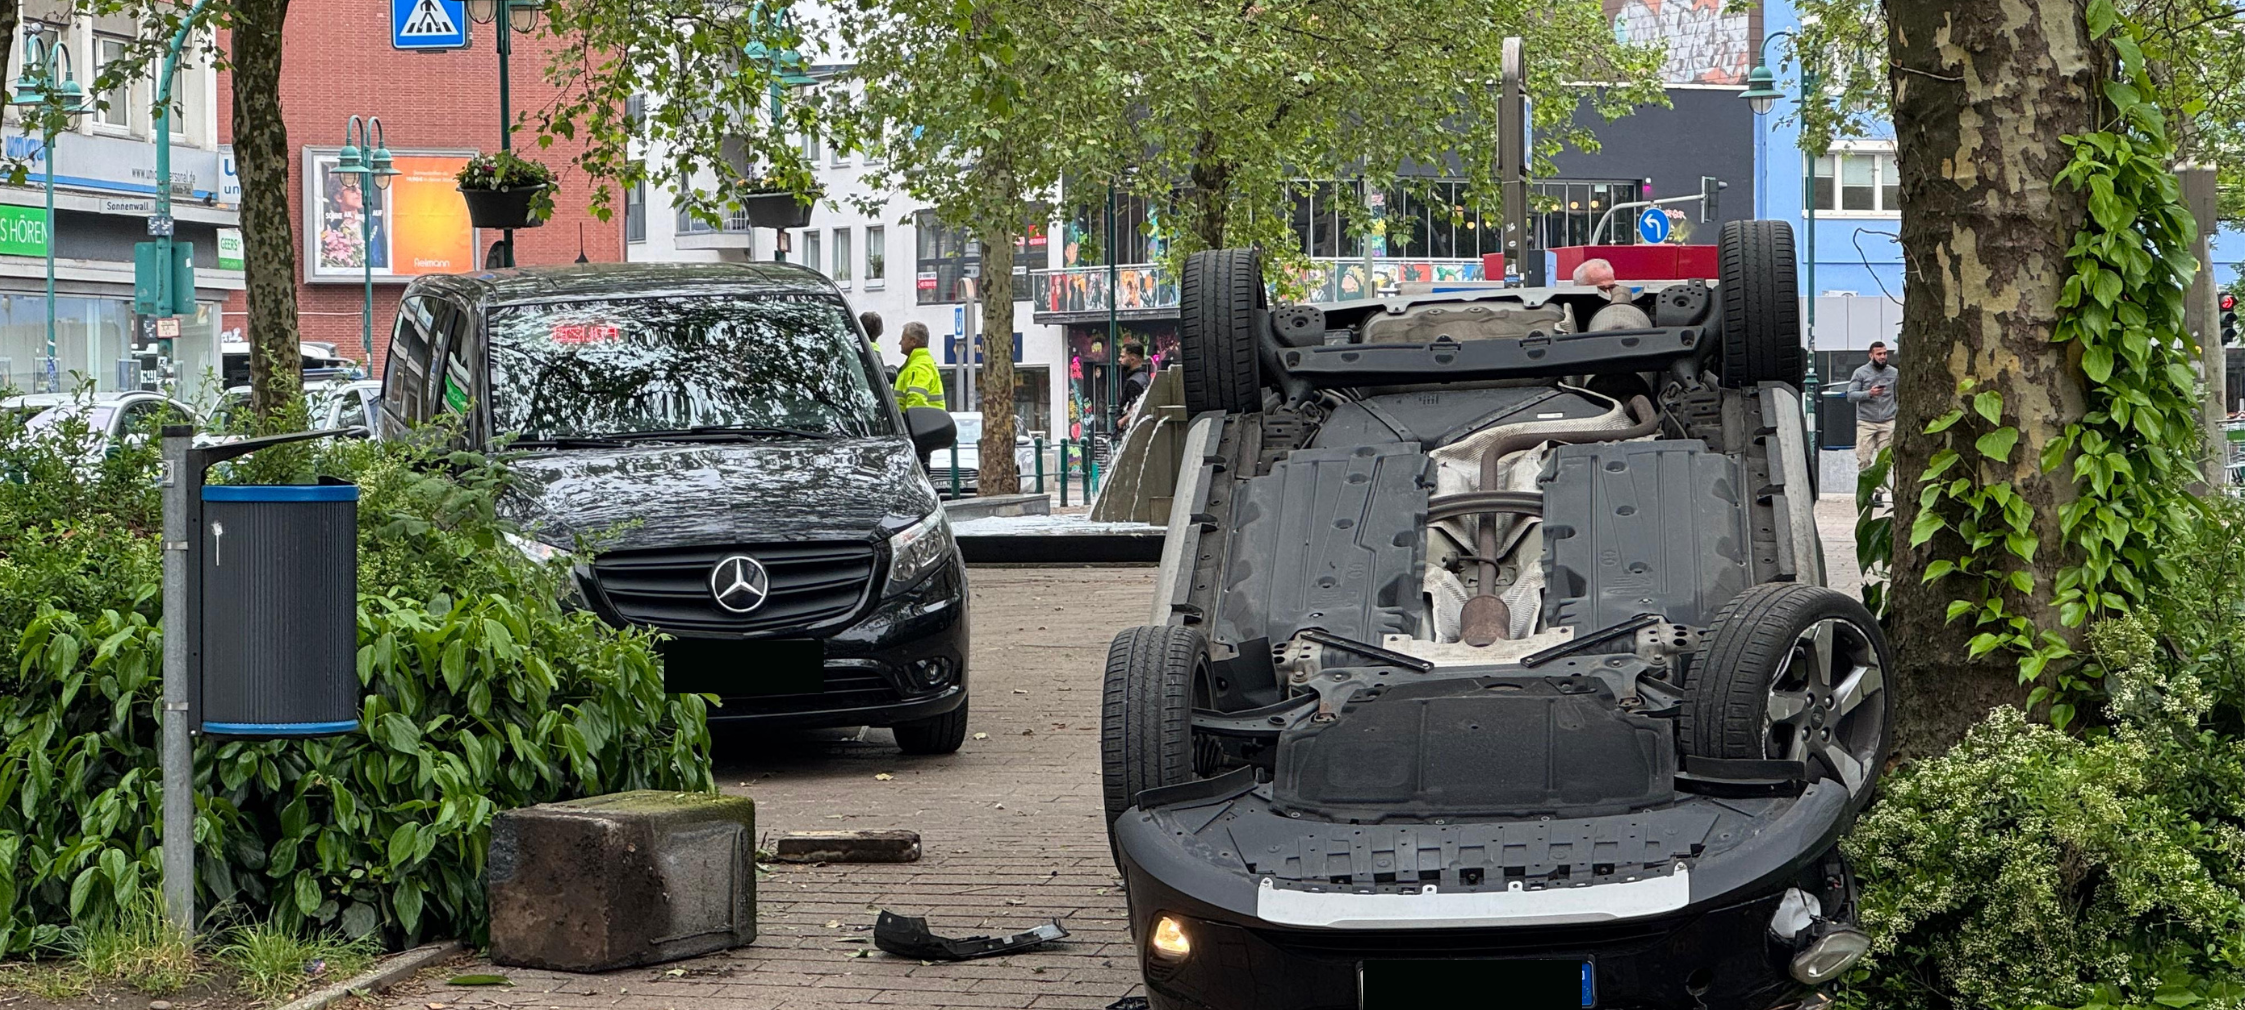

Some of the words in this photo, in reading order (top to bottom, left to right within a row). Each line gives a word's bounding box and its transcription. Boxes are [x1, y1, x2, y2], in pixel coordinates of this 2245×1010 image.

[106, 201, 149, 211] Sonnenwall
[9, 215, 48, 244] HÖREN
[221, 237, 238, 251] GEERS
